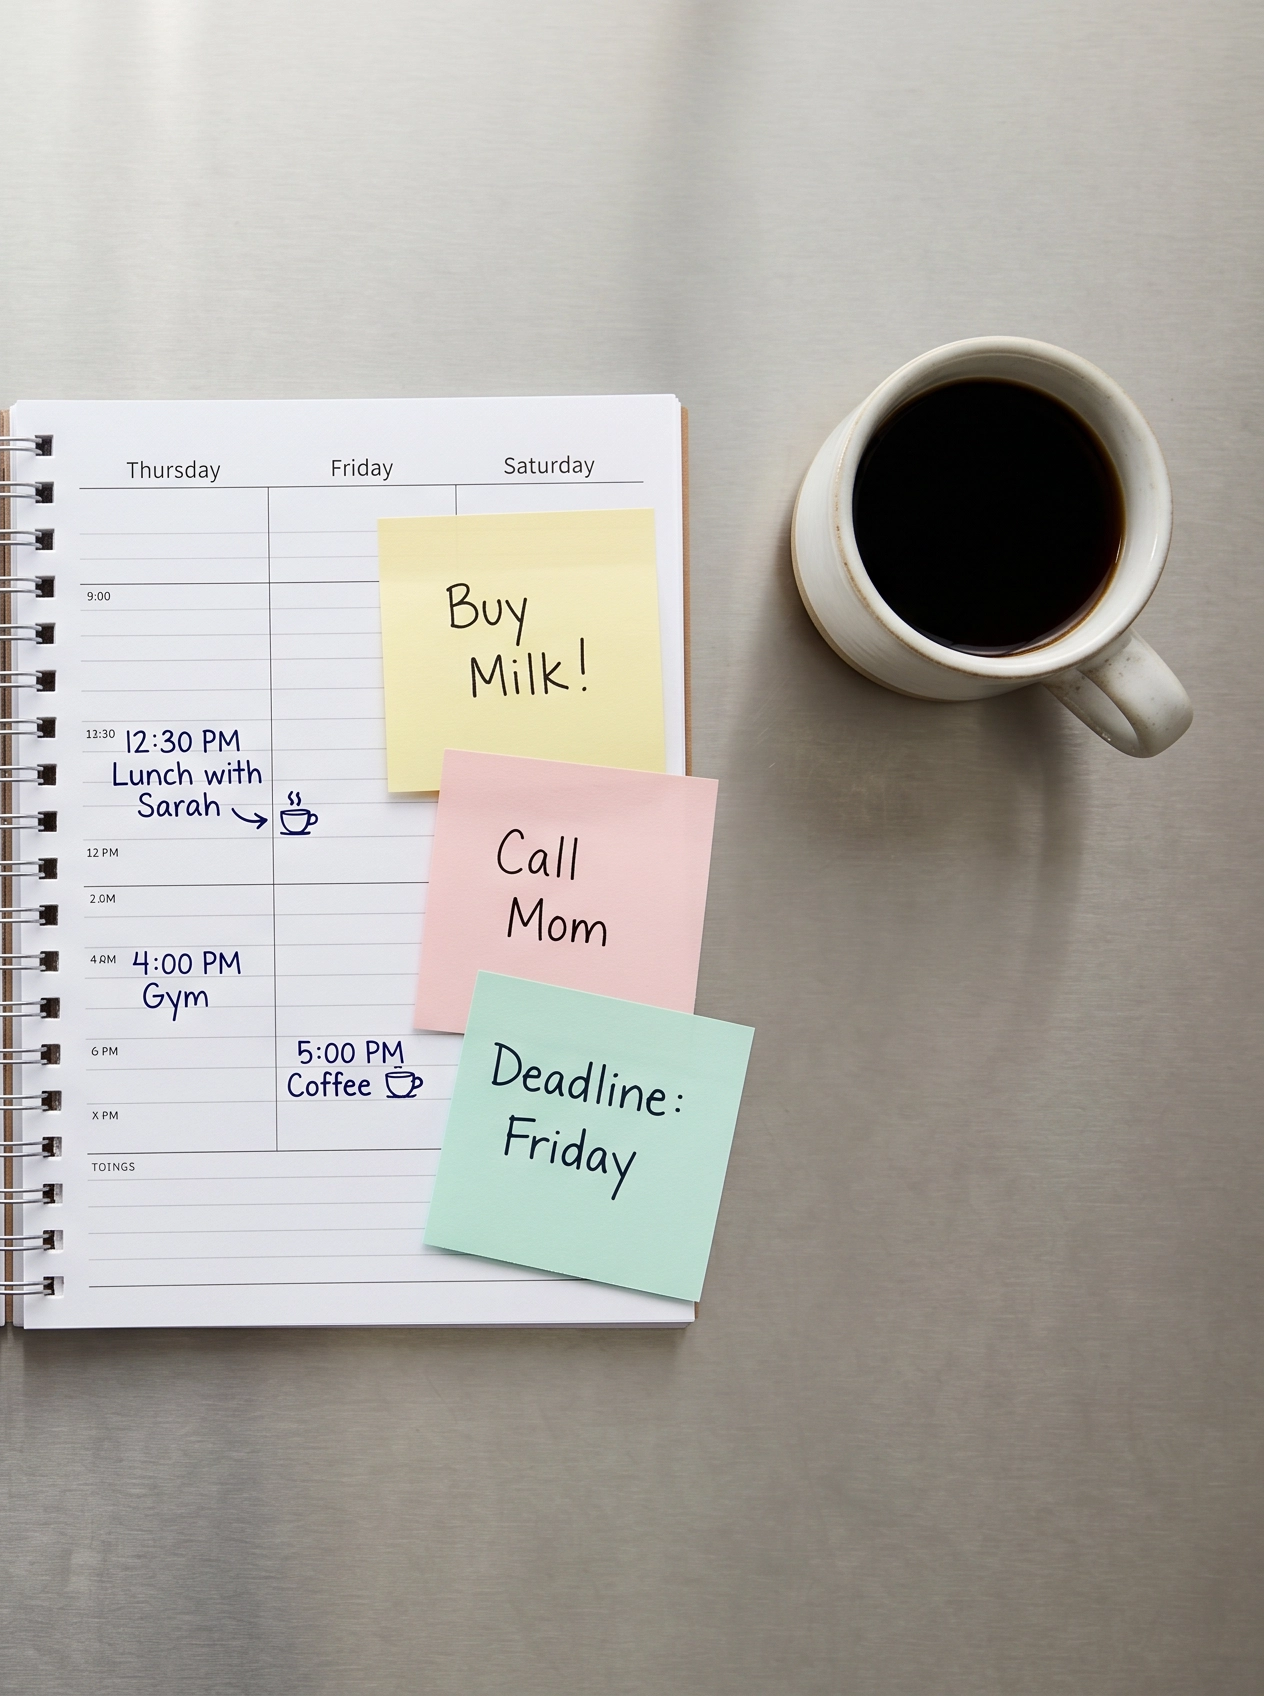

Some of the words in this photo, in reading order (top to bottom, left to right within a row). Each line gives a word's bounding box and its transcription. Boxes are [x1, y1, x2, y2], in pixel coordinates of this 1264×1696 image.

[126, 459, 221, 484] Thursday
[331, 457, 394, 482] Friday
[503, 454, 595, 479] Saturday
[86, 591, 111, 602] 9:00
[445, 582, 528, 647] Buy
[470, 637, 587, 699] Milk!
[126, 729, 193, 754] 12:30
[201, 728, 241, 754] PM
[112, 760, 194, 787] Lunch
[203, 759, 263, 786] with
[137, 791, 221, 819] Sarah
[86, 847, 100, 858] 12
[101, 847, 119, 858] PM
[496, 828, 579, 881] Call
[506, 896, 607, 948] Mom
[132, 950, 193, 976] 4:00
[202, 950, 242, 975] PM
[142, 981, 209, 1022] Gym
[90, 1046, 99, 1057] 6
[101, 1046, 119, 1057] PM
[297, 1040, 356, 1065] 5:00
[365, 1039, 405, 1064] PM
[287, 1070, 372, 1098] Coffee
[491, 1041, 684, 1118] Deadline:
[91, 1110, 100, 1121] X
[102, 1110, 119, 1121] PM
[91, 1161, 136, 1172] TOINGS
[503, 1114, 637, 1201] Friday
